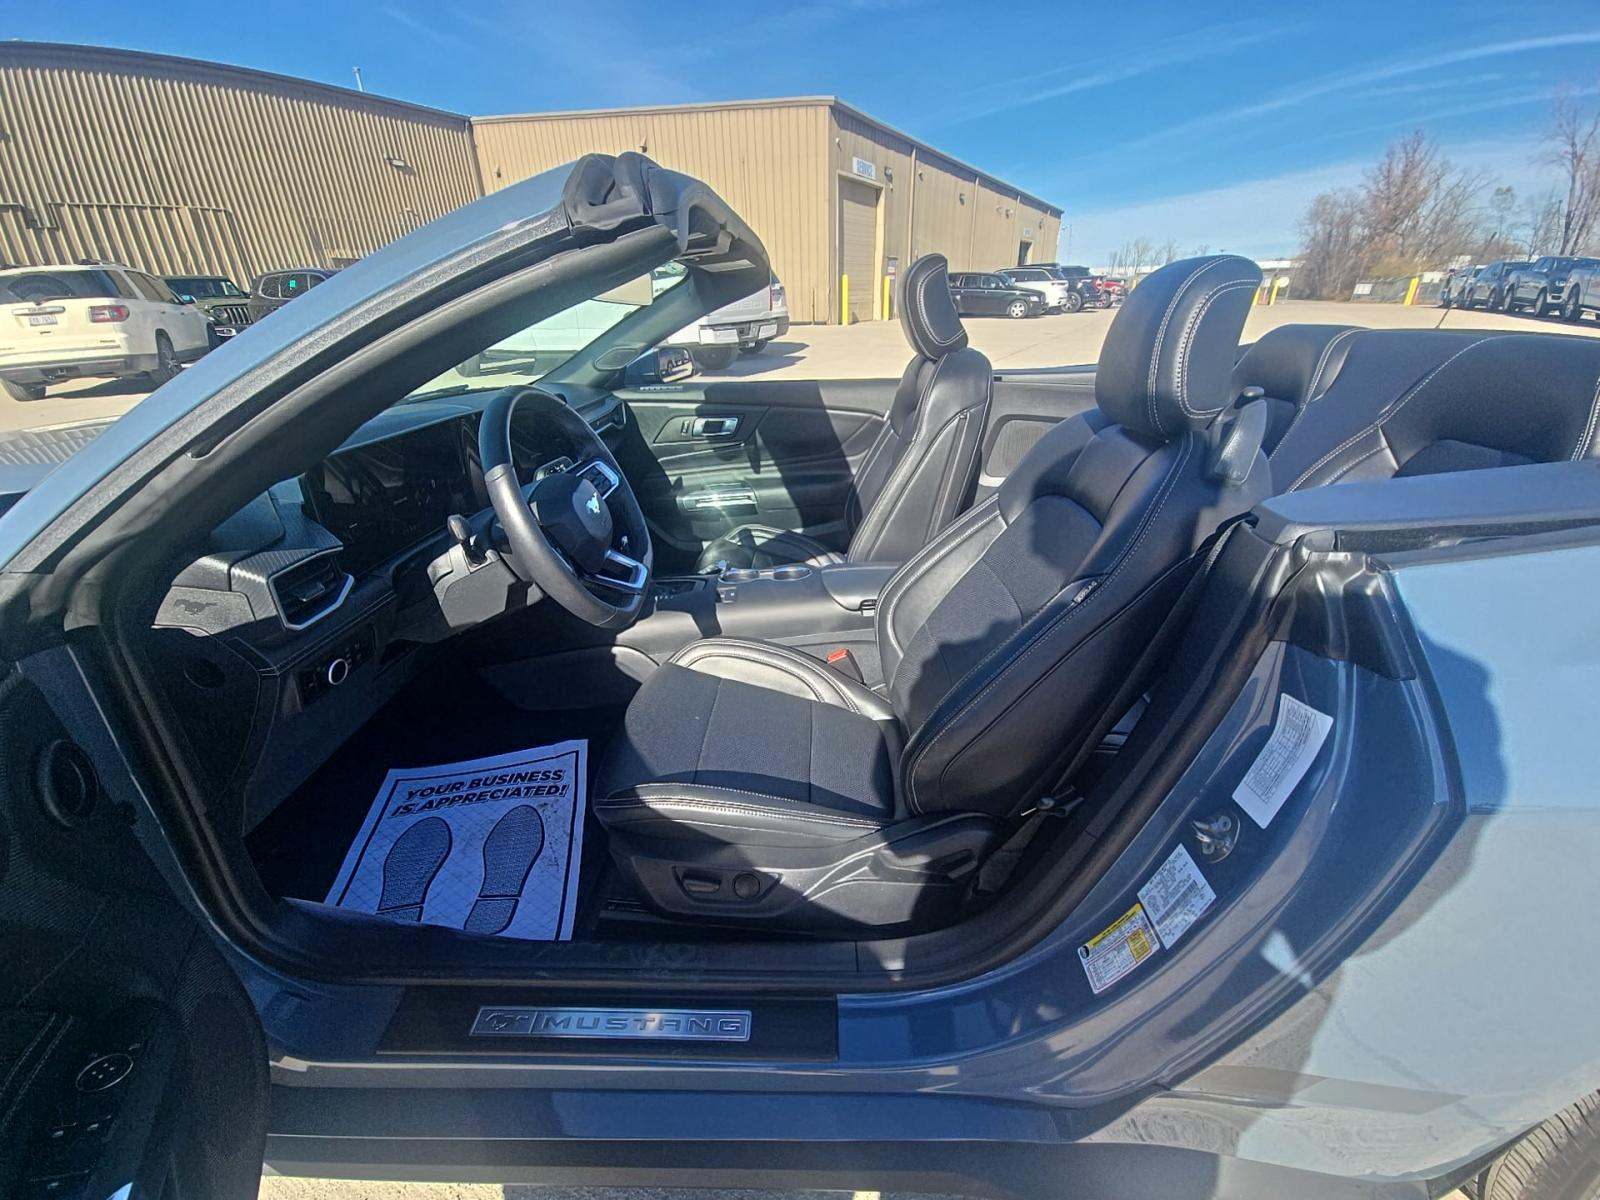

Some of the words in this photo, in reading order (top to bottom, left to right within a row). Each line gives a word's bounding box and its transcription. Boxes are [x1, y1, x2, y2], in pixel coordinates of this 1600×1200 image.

[390, 802, 417, 818] IS
[418, 784, 570, 812] APPRECIATED!
[406, 780, 466, 801] YOUR
[468, 769, 567, 790] BUSINESS
[541, 1015, 742, 1033] MUSTANG
